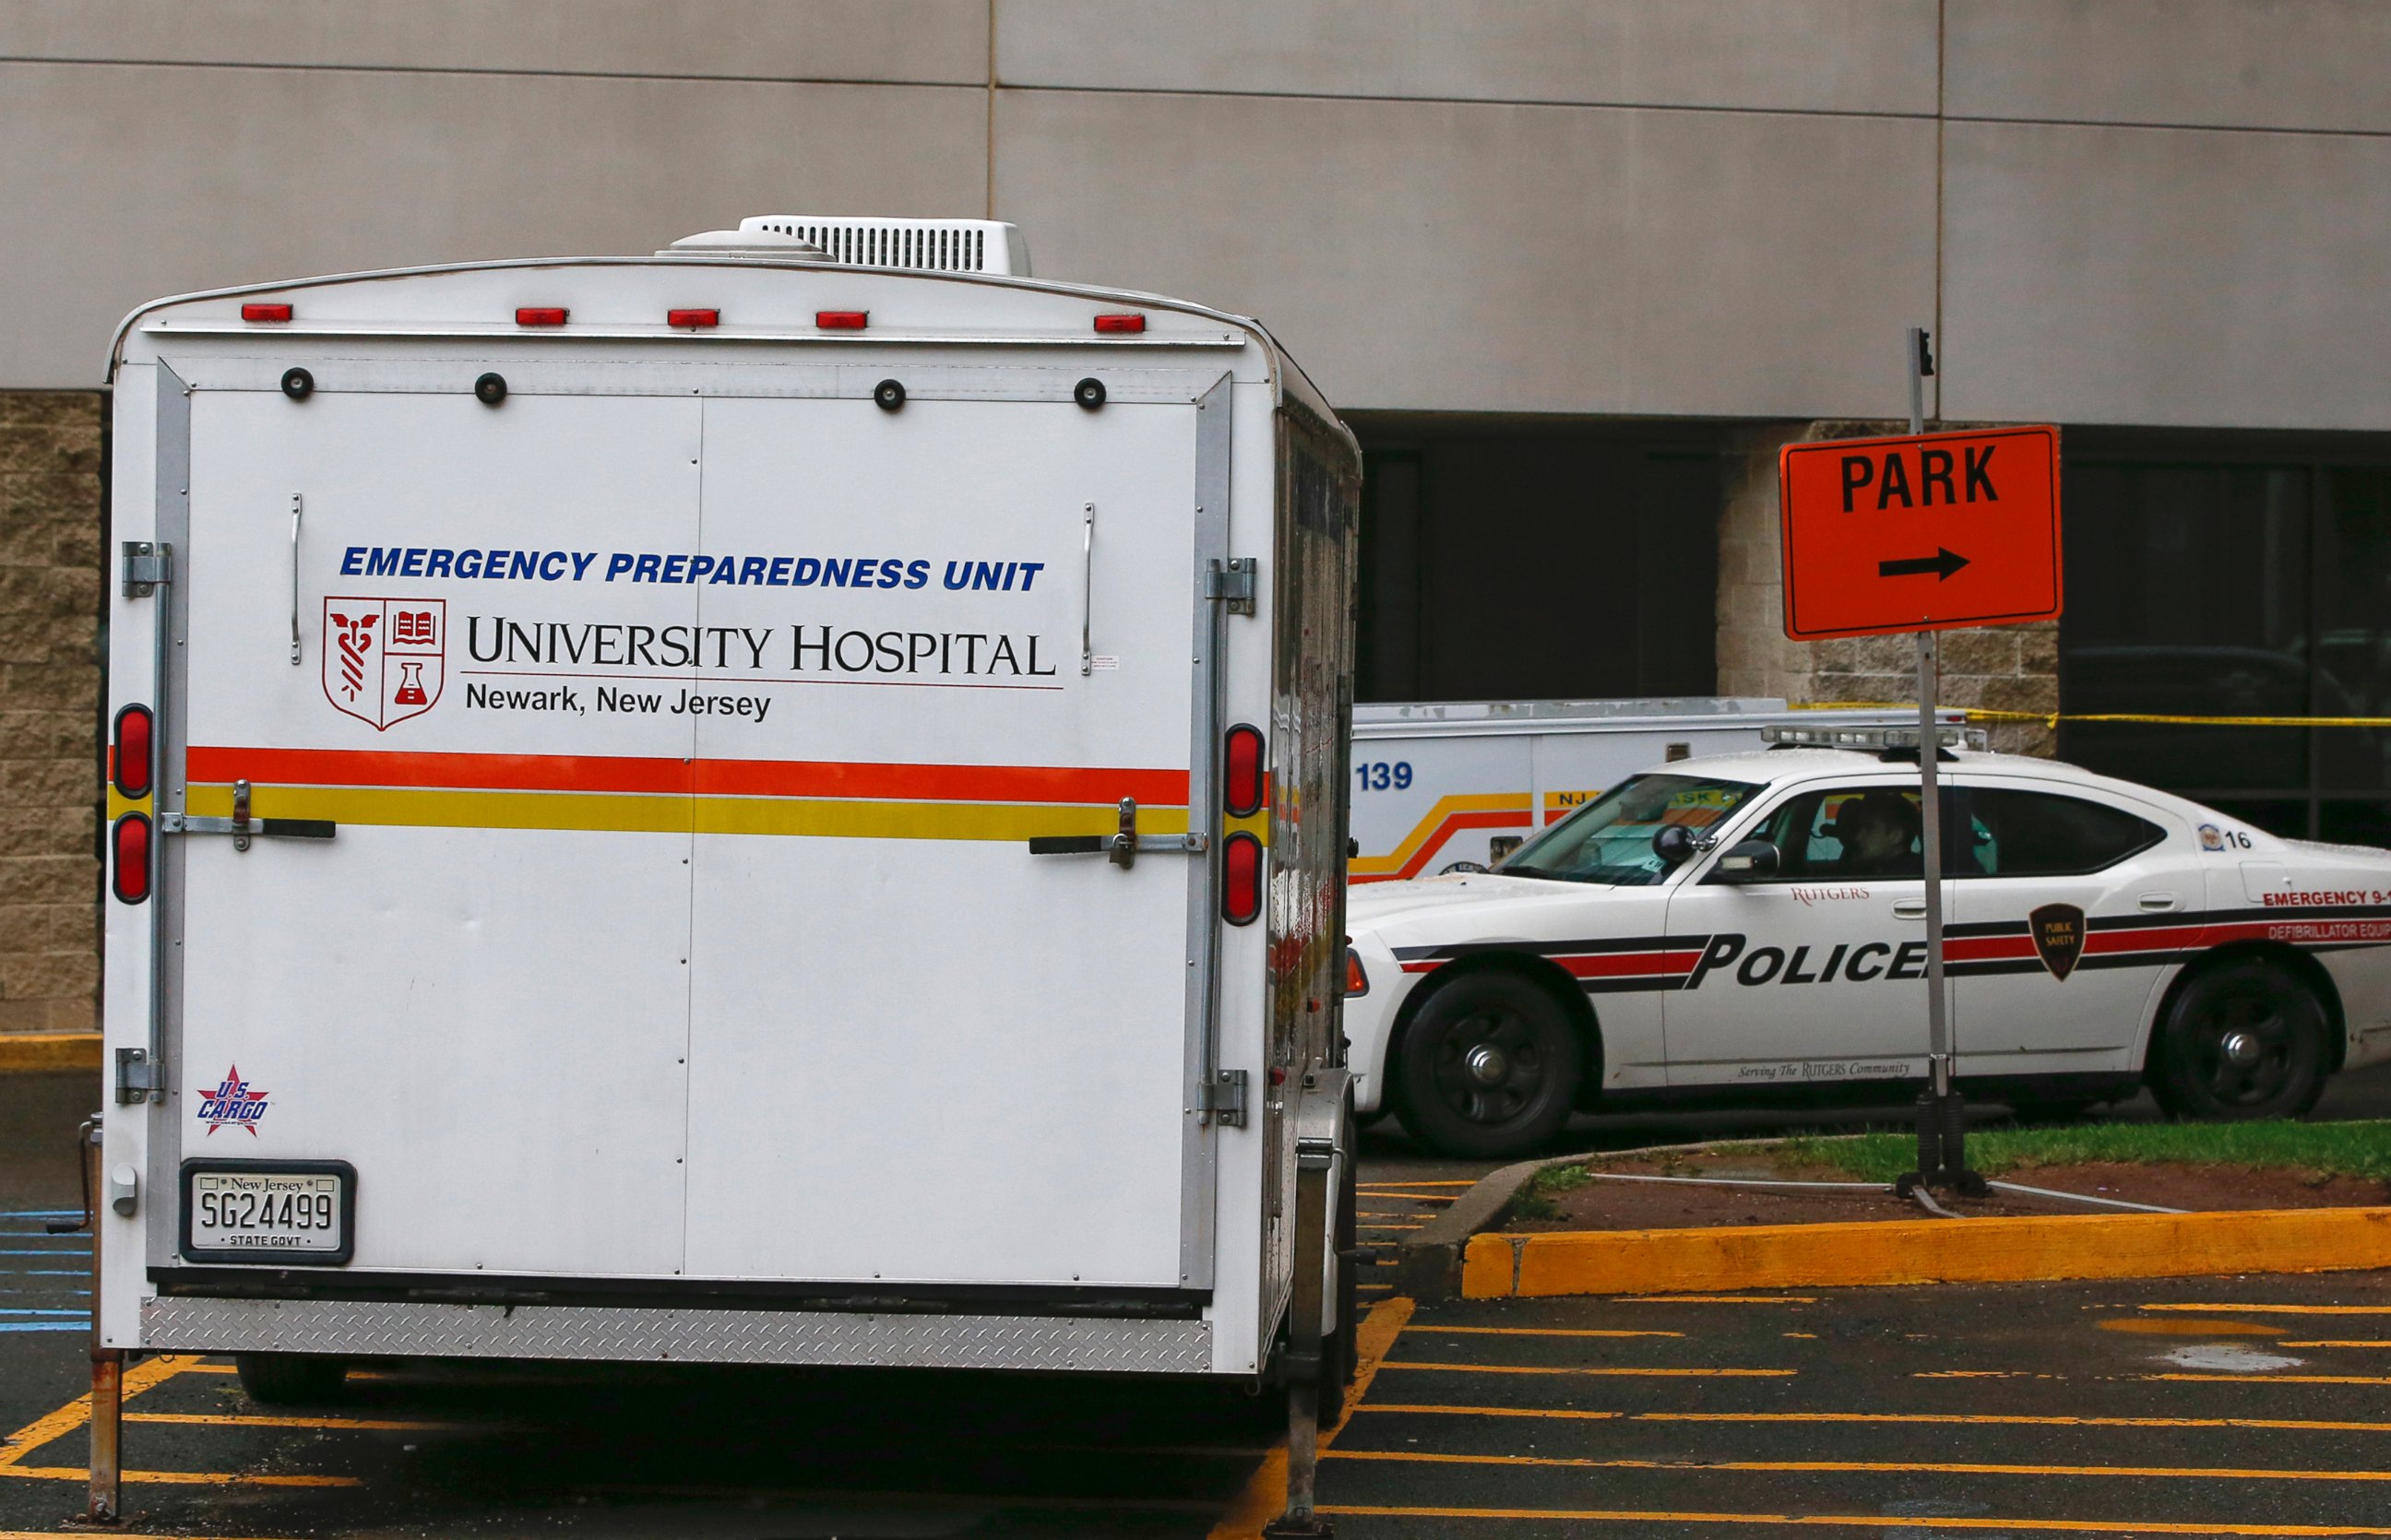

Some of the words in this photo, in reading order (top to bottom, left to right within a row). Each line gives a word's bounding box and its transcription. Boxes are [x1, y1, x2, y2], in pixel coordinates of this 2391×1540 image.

[1841, 444, 1999, 513] PARK
[339, 547, 600, 582] EMERGENCY
[605, 553, 931, 589] PREPAREDNESS
[943, 561, 1044, 591] UNIT
[467, 616, 774, 669] UNIVERSITY
[790, 625, 1057, 676] HOSPITAL
[466, 683, 586, 716] Newark,
[596, 686, 662, 714] New
[671, 689, 771, 723] Jersey
[1355, 762, 1412, 790] 139
[1559, 793, 1585, 805] NJ
[2225, 831, 2252, 849] 16
[1790, 887, 1870, 906] RUTGERS
[2263, 891, 2367, 906] EMERGENCY
[2045, 922, 2074, 933] PUBLIC
[2268, 925, 2358, 940] DEFIBRILLATOR
[2045, 935, 2076, 946] SAFETY
[1683, 933, 1927, 990] POLICE
[1738, 1066, 1777, 1079] Serving
[1779, 1064, 1797, 1076] The
[1802, 1062, 1846, 1081] RUTGERS
[1850, 1061, 1910, 1077] Community
[216, 1082, 250, 1099] U.S.
[197, 1100, 268, 1119] CARGO
[231, 1179, 262, 1190] New
[263, 1179, 303, 1193] Jersey
[201, 1192, 331, 1230] SG24499
[231, 1236, 268, 1246] STATE
[270, 1237, 302, 1246] GOVT
